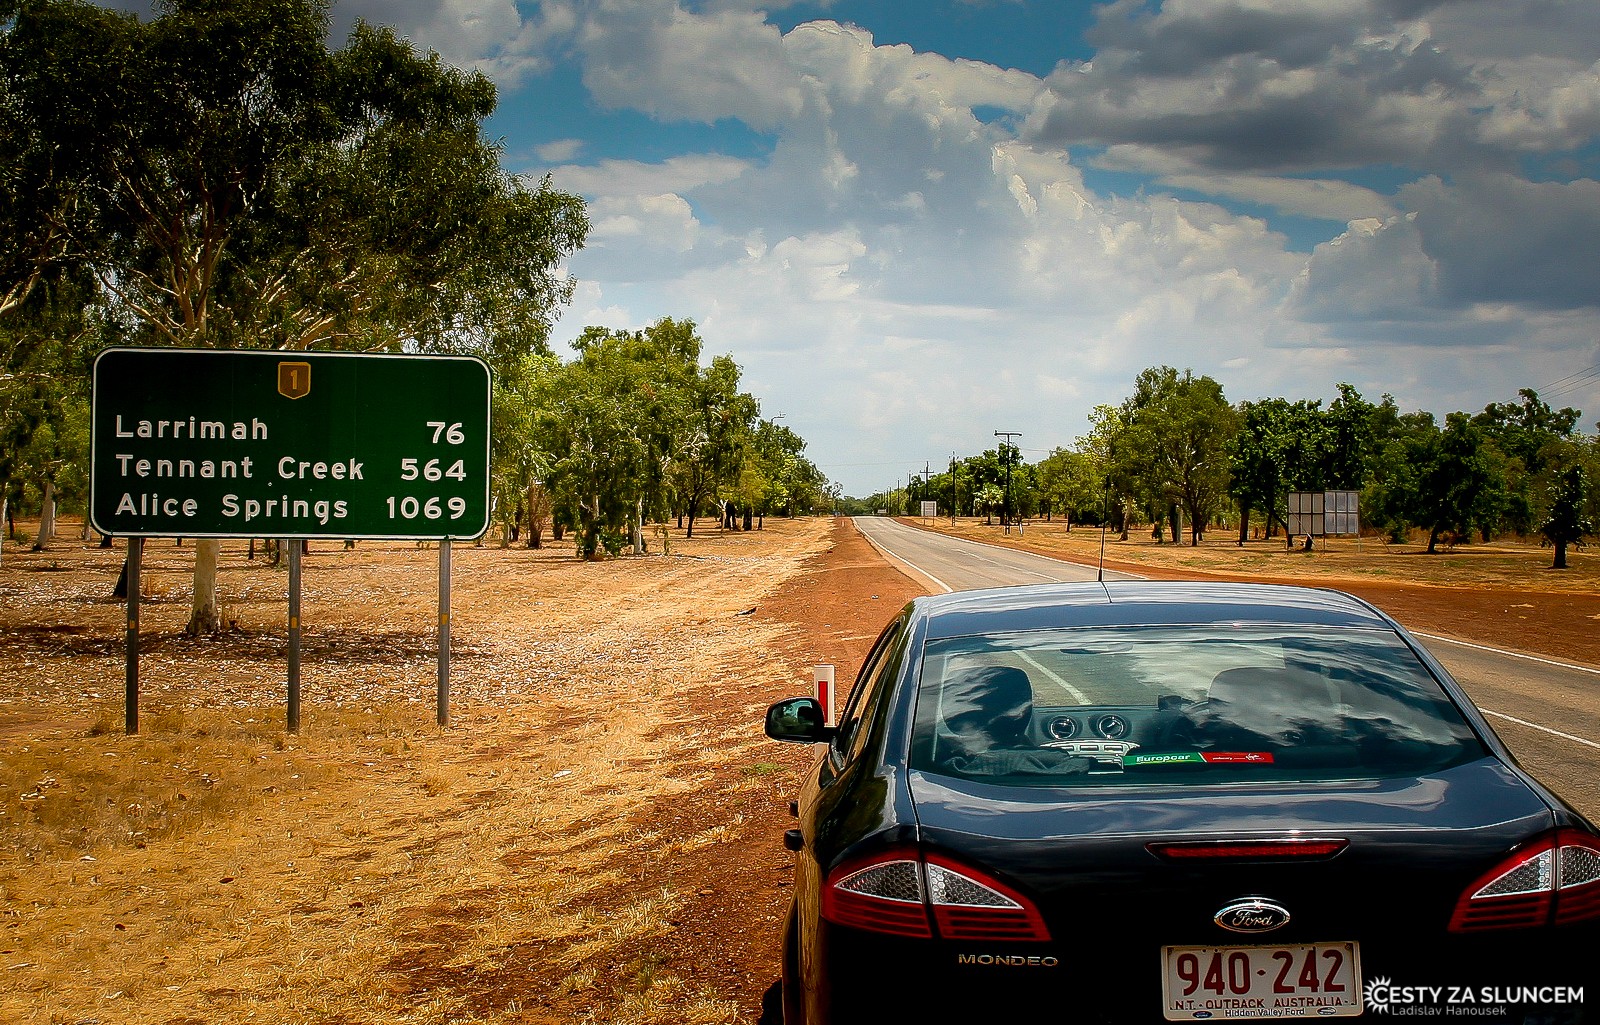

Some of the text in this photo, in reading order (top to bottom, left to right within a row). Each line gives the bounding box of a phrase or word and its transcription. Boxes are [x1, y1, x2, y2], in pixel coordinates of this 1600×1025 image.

[289, 368, 299, 390] 1
[115, 414, 465, 444] Larrimah 76
[115, 454, 467, 482] Tennant Creek 564
[115, 492, 466, 525] Alice Springs 1069
[1231, 909, 1274, 927] Ford
[958, 953, 1059, 967] MONDEO
[1205, 999, 1265, 1009] OUTBACK
[1273, 997, 1343, 1007] AUSTRALIA
[1225, 1007, 1305, 1017] Hidden Valley Ford
